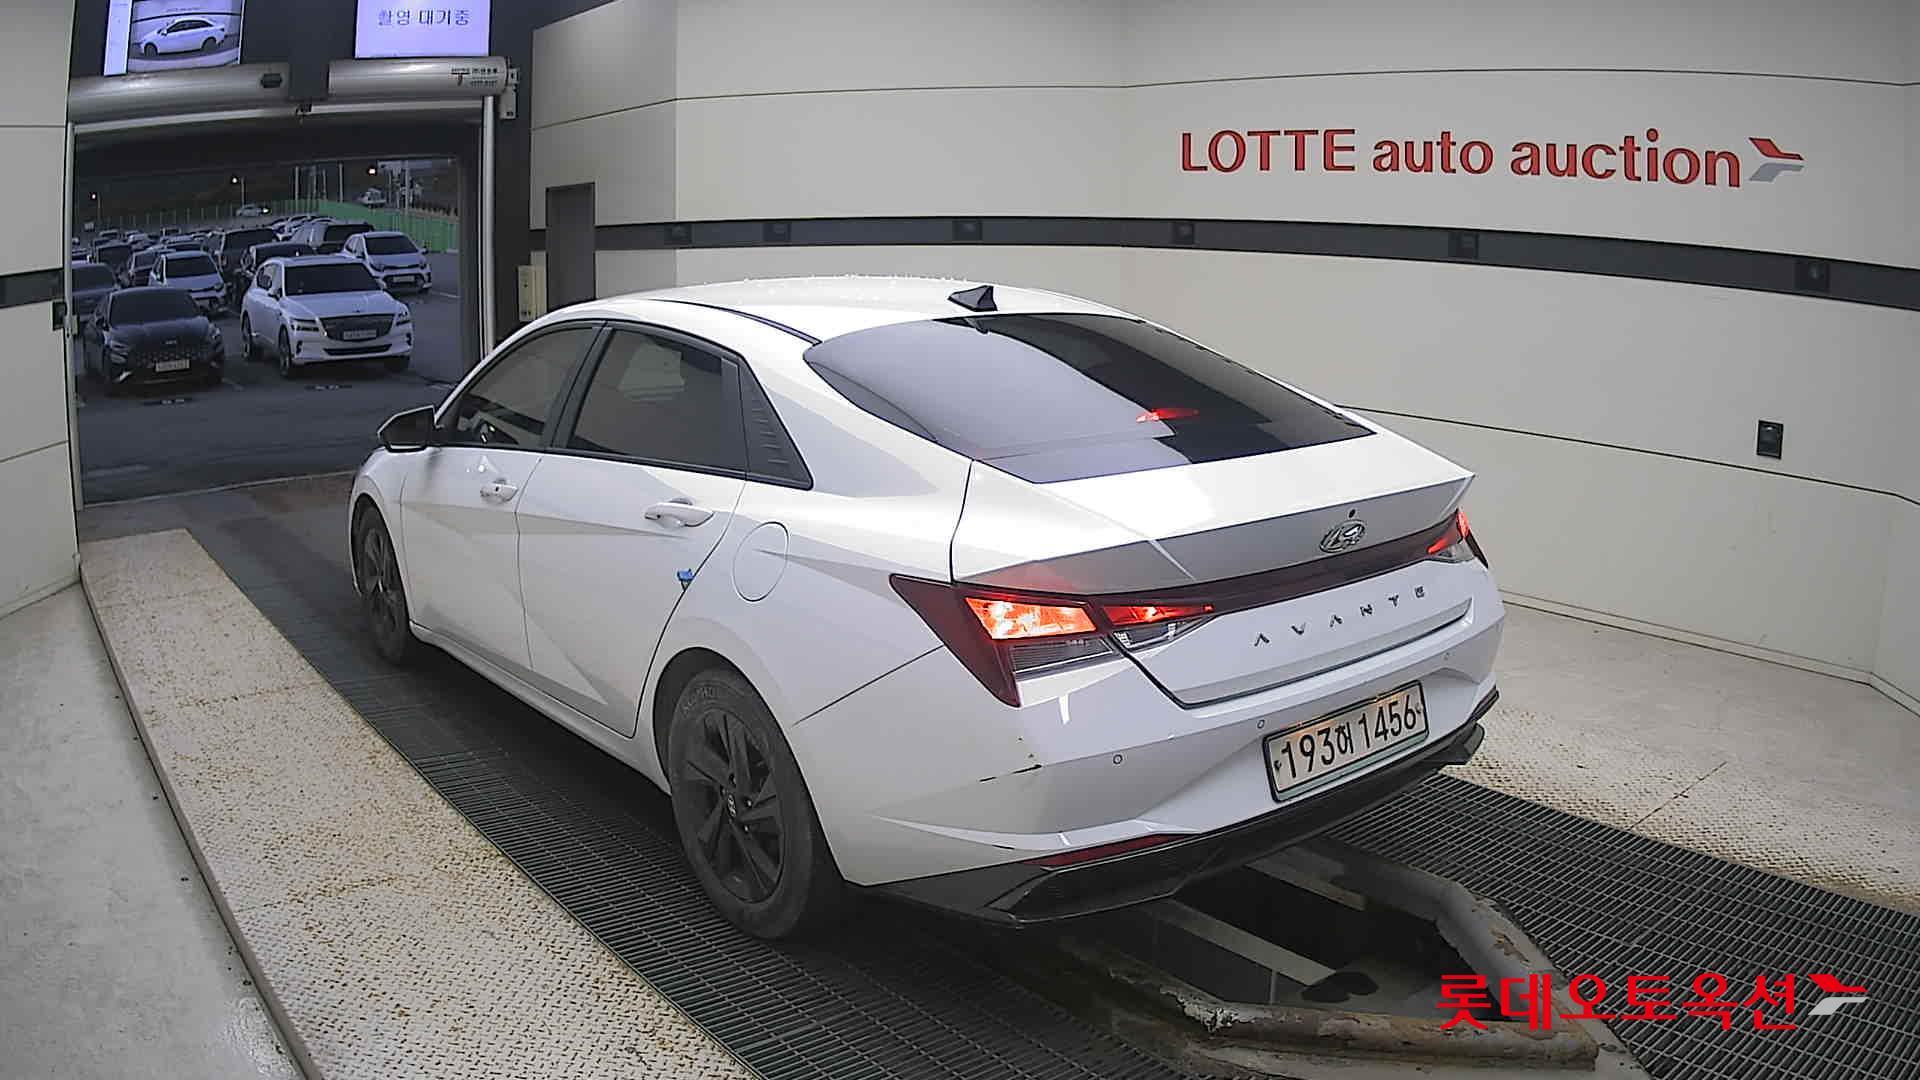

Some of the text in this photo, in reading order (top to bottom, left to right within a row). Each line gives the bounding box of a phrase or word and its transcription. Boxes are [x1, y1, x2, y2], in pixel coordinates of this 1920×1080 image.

[418, 9, 470, 26] 대기중
[1180, 128, 1742, 187] LOTTE auto auction
[1253, 585, 1426, 648] AVANTE
[1281, 694, 1417, 779] 193허 1456
